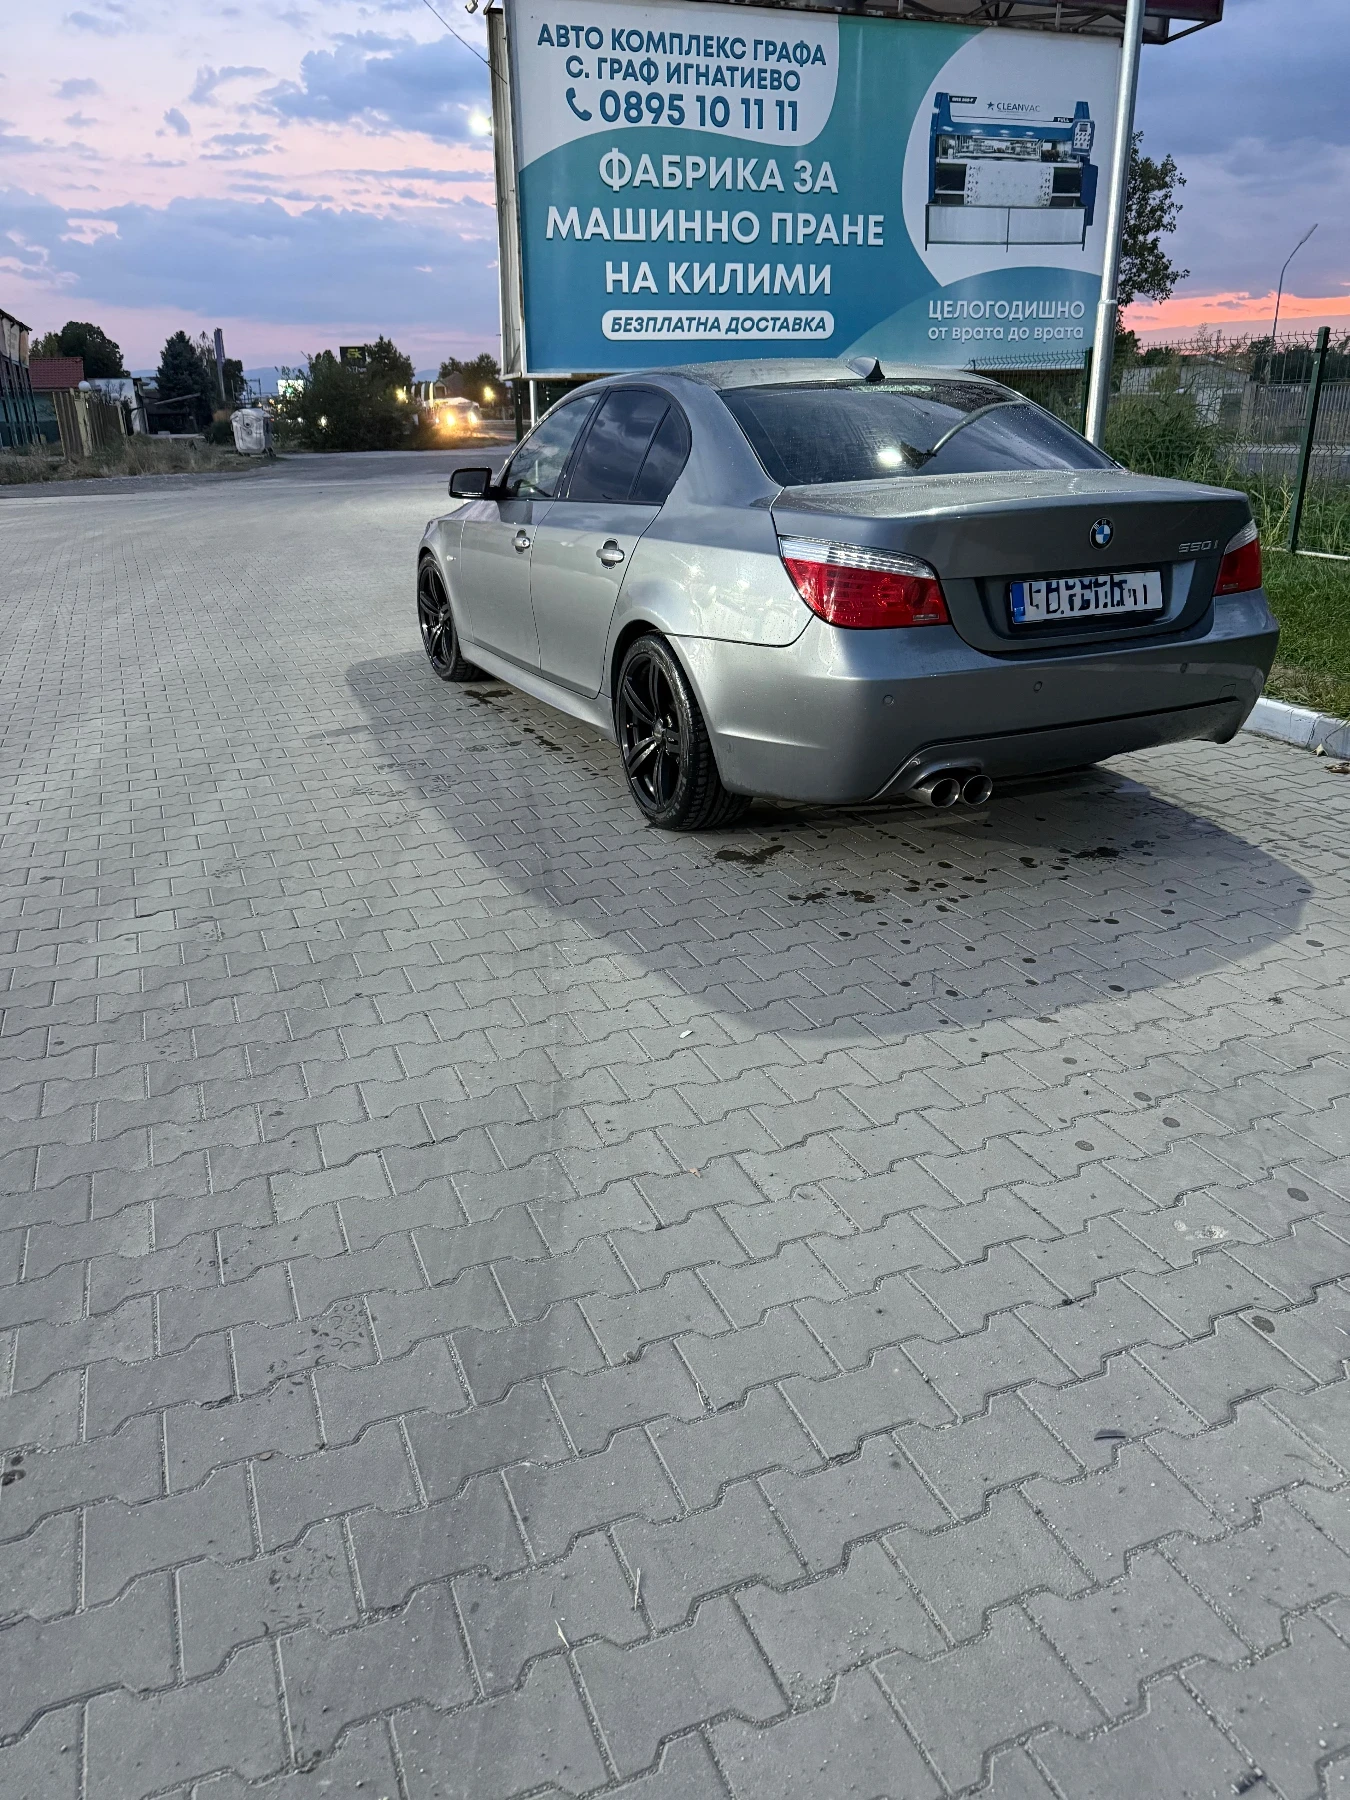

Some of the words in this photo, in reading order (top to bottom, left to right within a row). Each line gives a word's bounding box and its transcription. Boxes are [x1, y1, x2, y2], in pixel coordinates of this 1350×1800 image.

[537, 23, 604, 50] АВТО
[611, 28, 746, 60] КОМПЛЕКС
[753, 39, 827, 67] ГРАФА
[566, 55, 590, 79] С.
[597, 57, 659, 85] ГРАФ
[666, 62, 801, 91] ИГНАТИЕВО
[599, 89, 686, 126] 0895
[695, 95, 730, 128] 10
[740, 97, 764, 130] 11
[775, 100, 798, 132] 11
[996, 102, 1041, 112] CLEANVAC
[600, 148, 785, 192] ФАБРИКА
[793, 160, 839, 194] ЗА
[546, 205, 760, 244] МАШИННО
[771, 212, 885, 247] ПРАНЕ
[605, 261, 659, 294] НА
[668, 262, 831, 295] КИЛИМИ
[611, 316, 722, 333] БЕЗПЛАТНА
[725, 317, 827, 335] ДОСТАВКА
[929, 300, 1085, 322] ЦЕЛОГОДИШНО
[928, 327, 948, 340] от
[952, 327, 1004, 343] врата
[1008, 327, 1030, 342] до
[1034, 327, 1084, 343] врата
